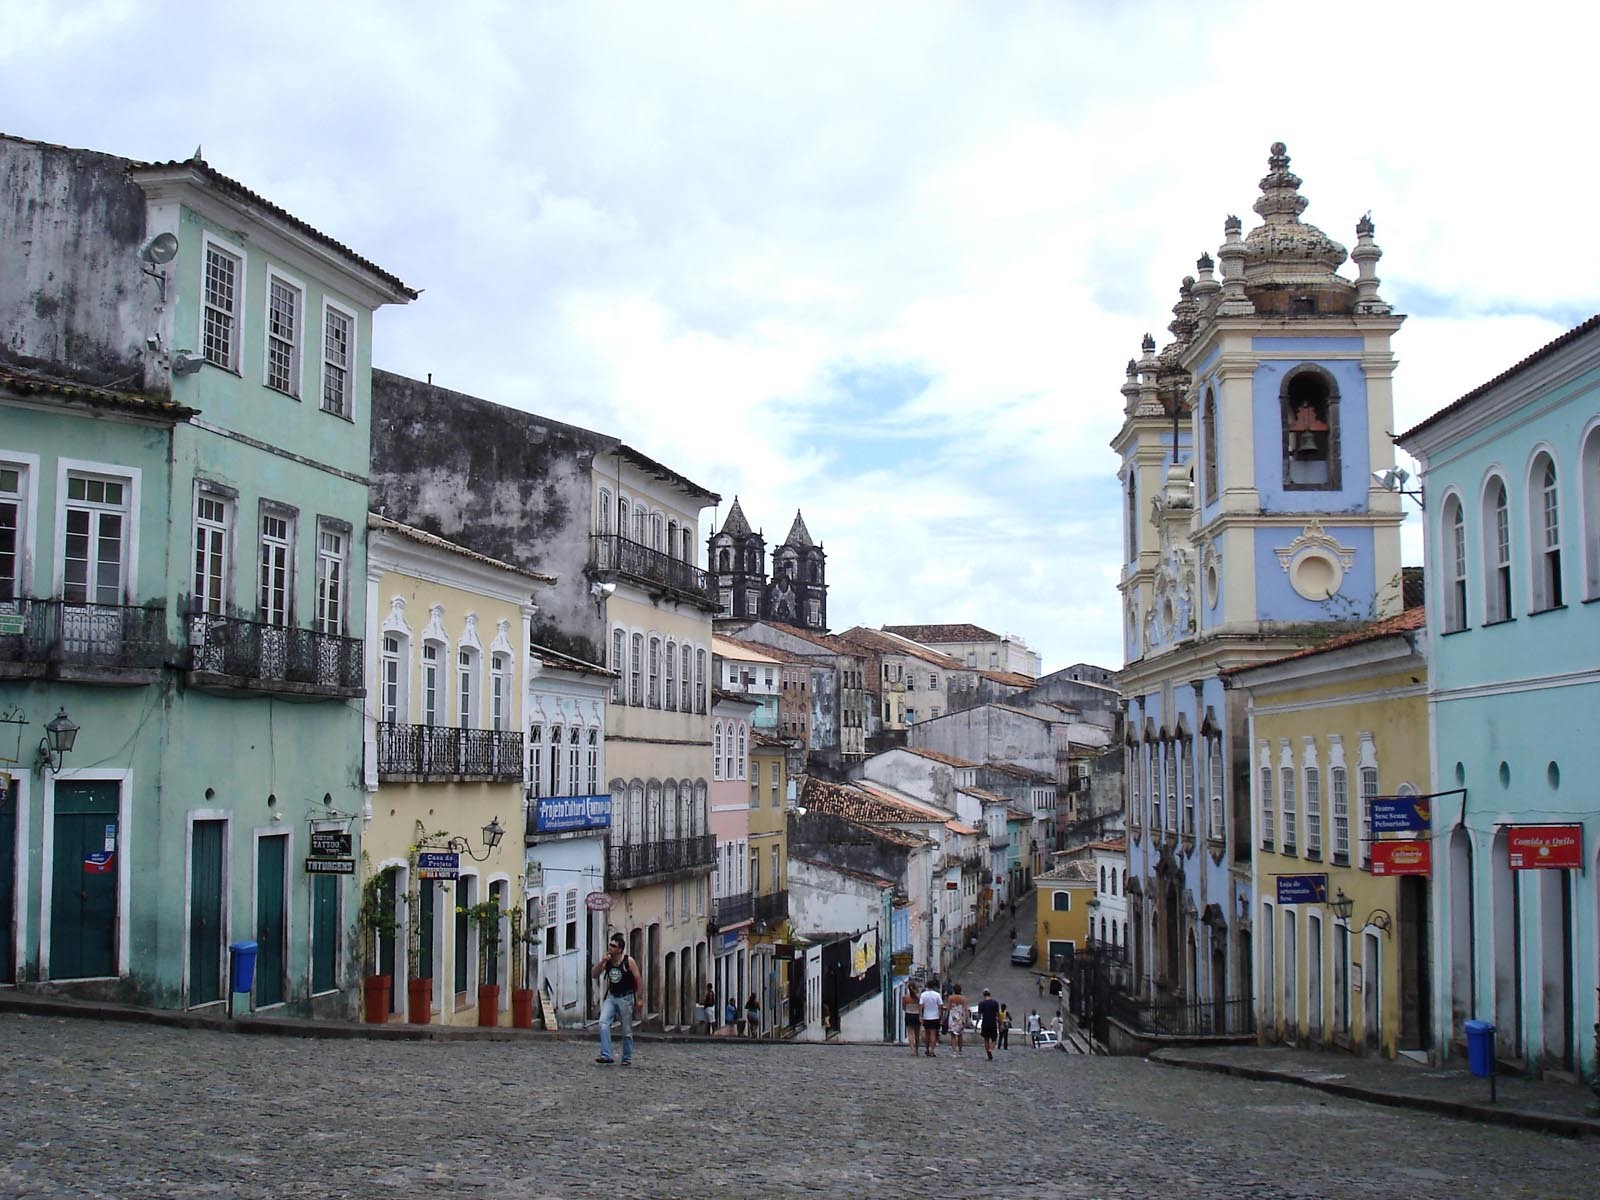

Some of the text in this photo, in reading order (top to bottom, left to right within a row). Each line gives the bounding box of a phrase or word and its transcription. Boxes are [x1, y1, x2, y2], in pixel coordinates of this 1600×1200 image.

[541, 801, 564, 820] Projeto
[564, 799, 586, 817] Cultural
[312, 841, 340, 849] TATTOO
[1513, 838, 1543, 846] Comida
[1552, 837, 1575, 847] Quilo
[428, 861, 452, 869] Projeto
